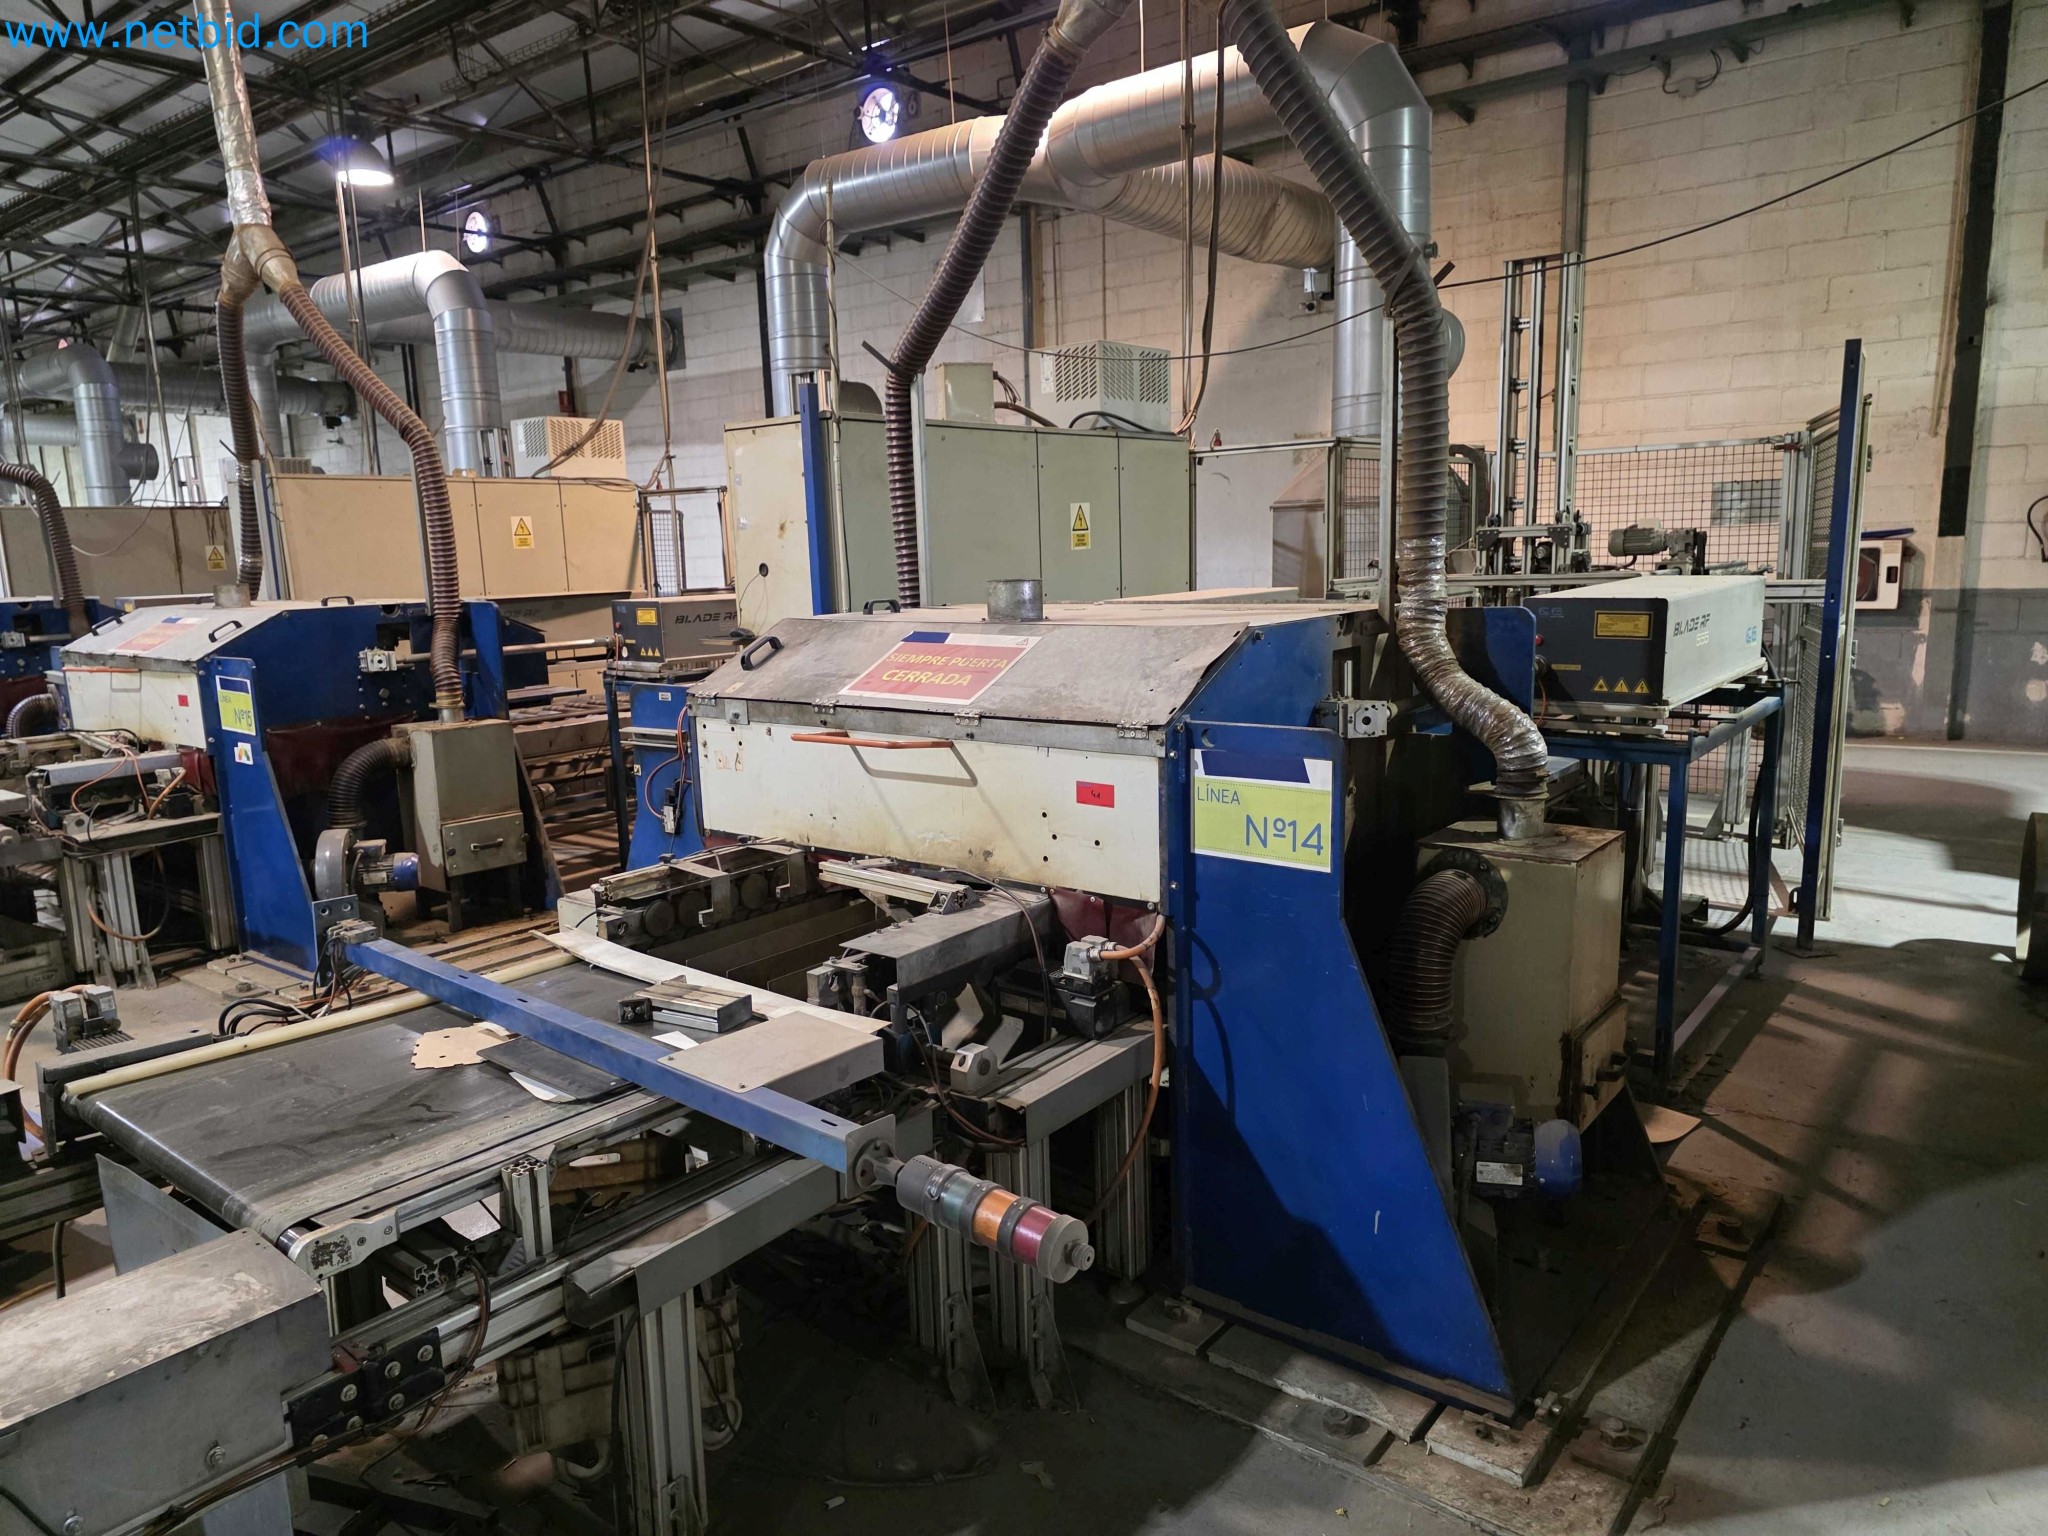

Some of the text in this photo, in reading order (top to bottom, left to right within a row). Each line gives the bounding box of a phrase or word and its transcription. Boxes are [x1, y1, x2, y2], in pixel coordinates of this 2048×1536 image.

[674, 612, 721, 624] BLADE
[1672, 613, 1711, 638] BLADE RF
[886, 652, 1008, 669] SIEMPRE PUERTA
[881, 669, 973, 686] CERRADA
[1197, 783, 1241, 806] LÍNEA
[1245, 814, 1324, 856] Nº14
